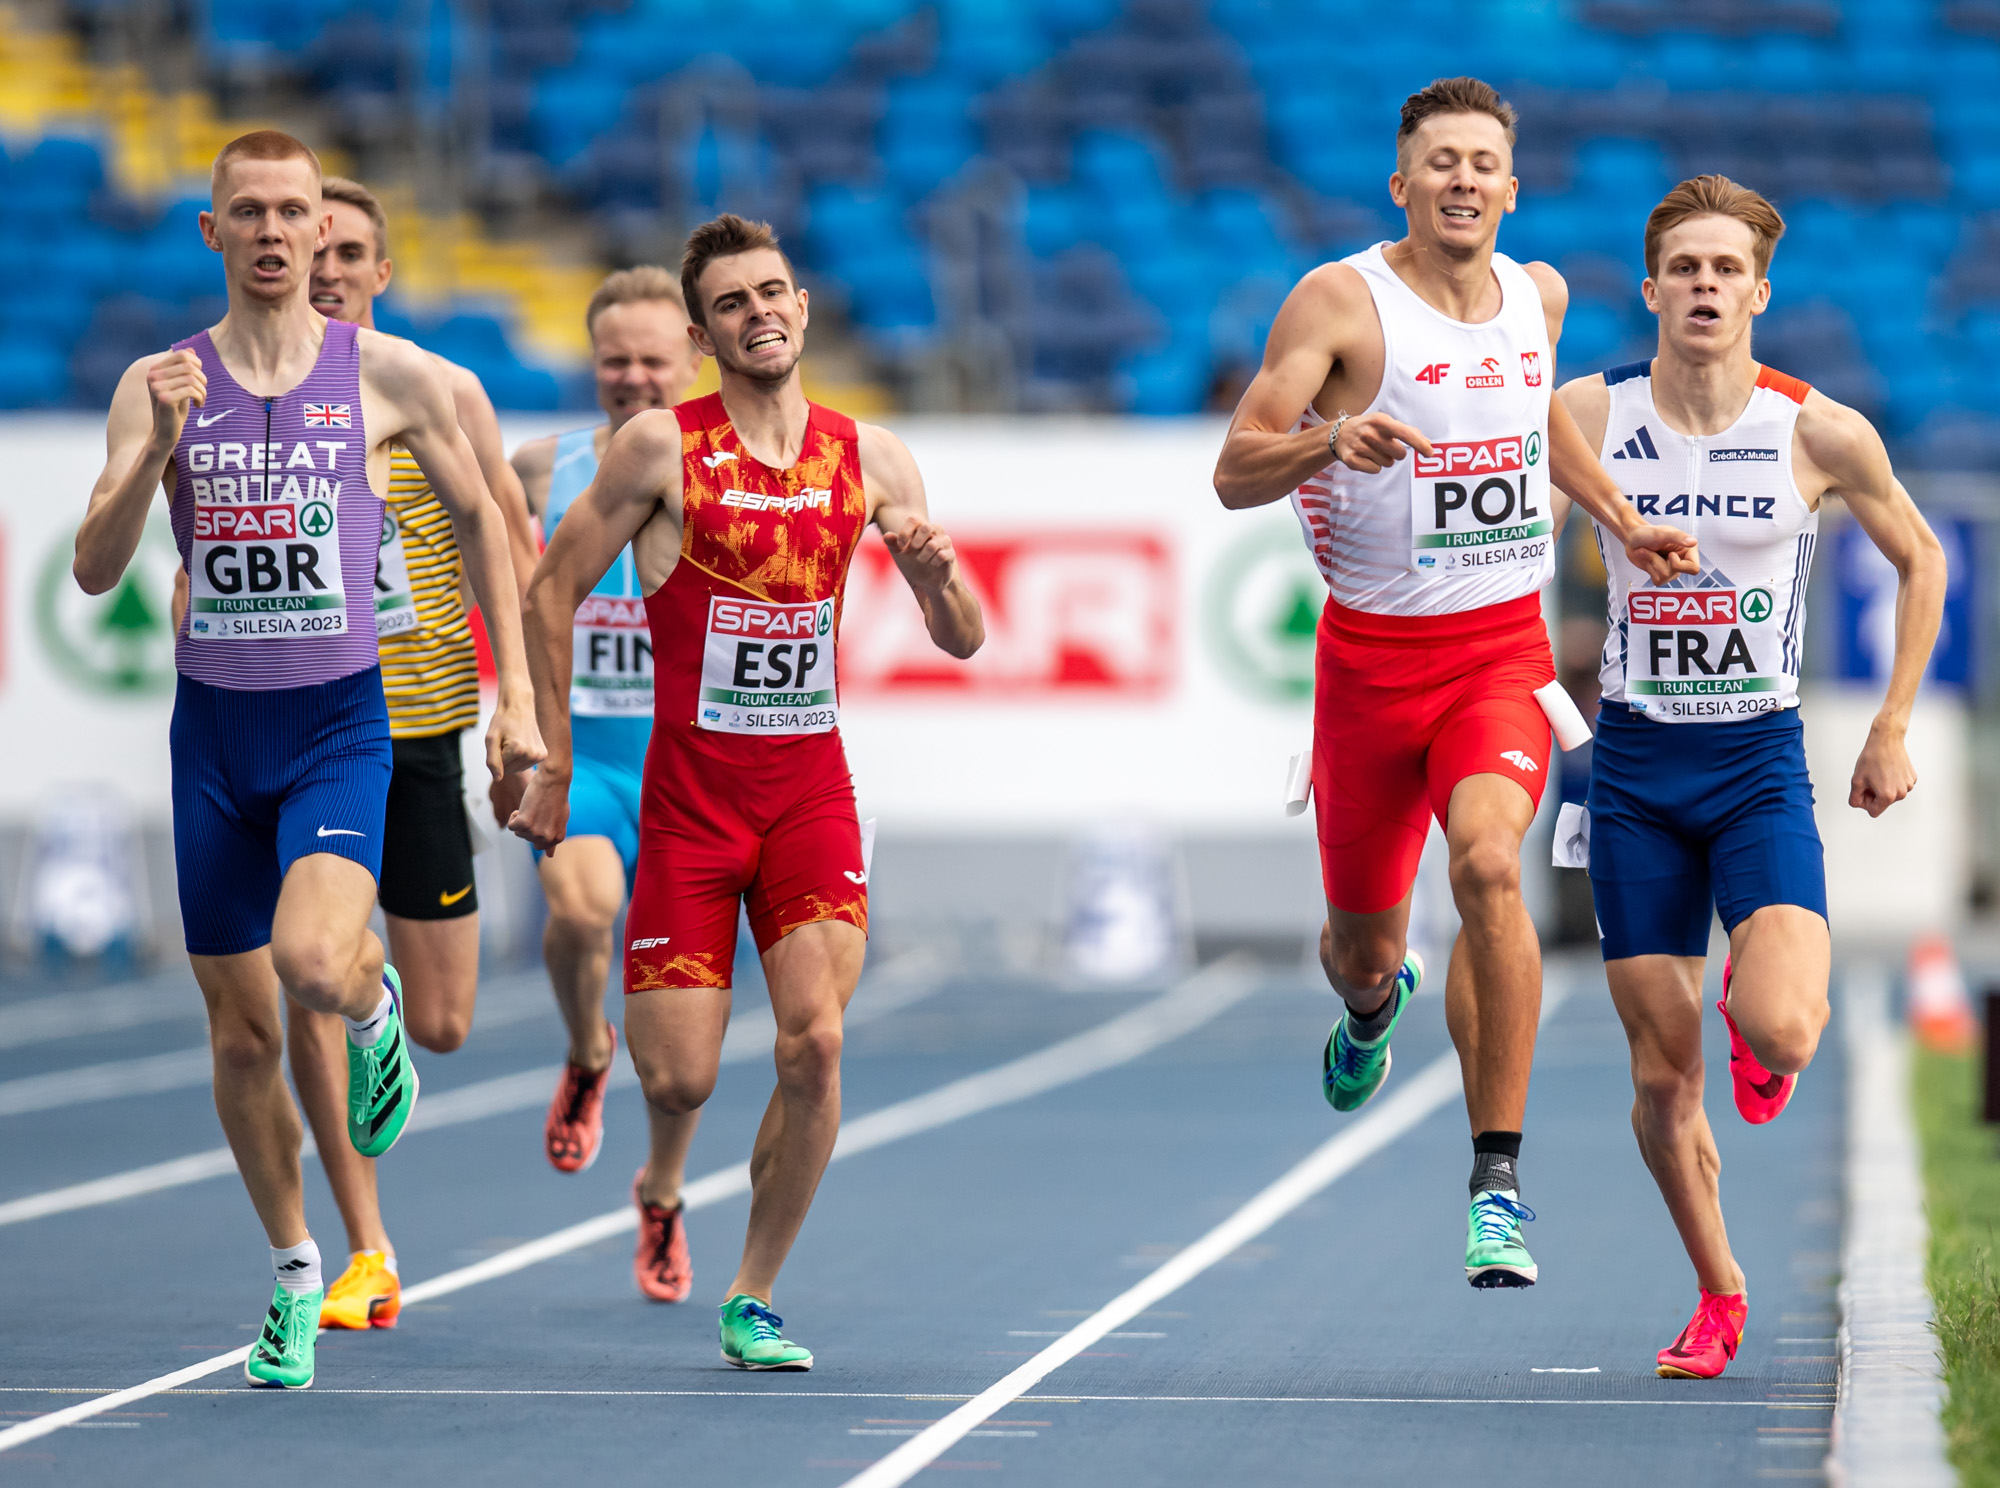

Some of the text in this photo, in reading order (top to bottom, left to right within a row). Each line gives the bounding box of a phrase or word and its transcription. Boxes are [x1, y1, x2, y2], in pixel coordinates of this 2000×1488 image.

[1415, 363, 1451, 385] 4F
[1467, 376, 1502, 387] ORLEN
[188, 440, 347, 472] GREAT
[1417, 441, 1520, 473] SPAR
[1711, 451, 1777, 460] Crédit Mutuel
[191, 474, 342, 503] BRITAIN
[719, 487, 832, 513] ESPAÑA
[1434, 473, 1538, 529] POL
[1624, 494, 1776, 519] RANCE
[195, 508, 293, 536] SPAR
[1453, 532, 1483, 546] RUN
[1461, 540, 1549, 567] SILESIA 202
[204, 543, 328, 595] GBR
[223, 599, 255, 612] RUN
[1631, 595, 1734, 621] SPAR
[233, 615, 342, 634] SILESIA 2023
[714, 604, 815, 635] SPAR
[590, 632, 653, 673] FIN
[732, 641, 819, 689] ESP
[1649, 628, 1758, 676] FRA
[740, 693, 769, 705] RUN
[1663, 682, 1694, 694] RUN
[745, 710, 836, 728] SILESIA 2023
[1672, 698, 1777, 716] SILESIA 2023
[630, 937, 670, 951] ESP
